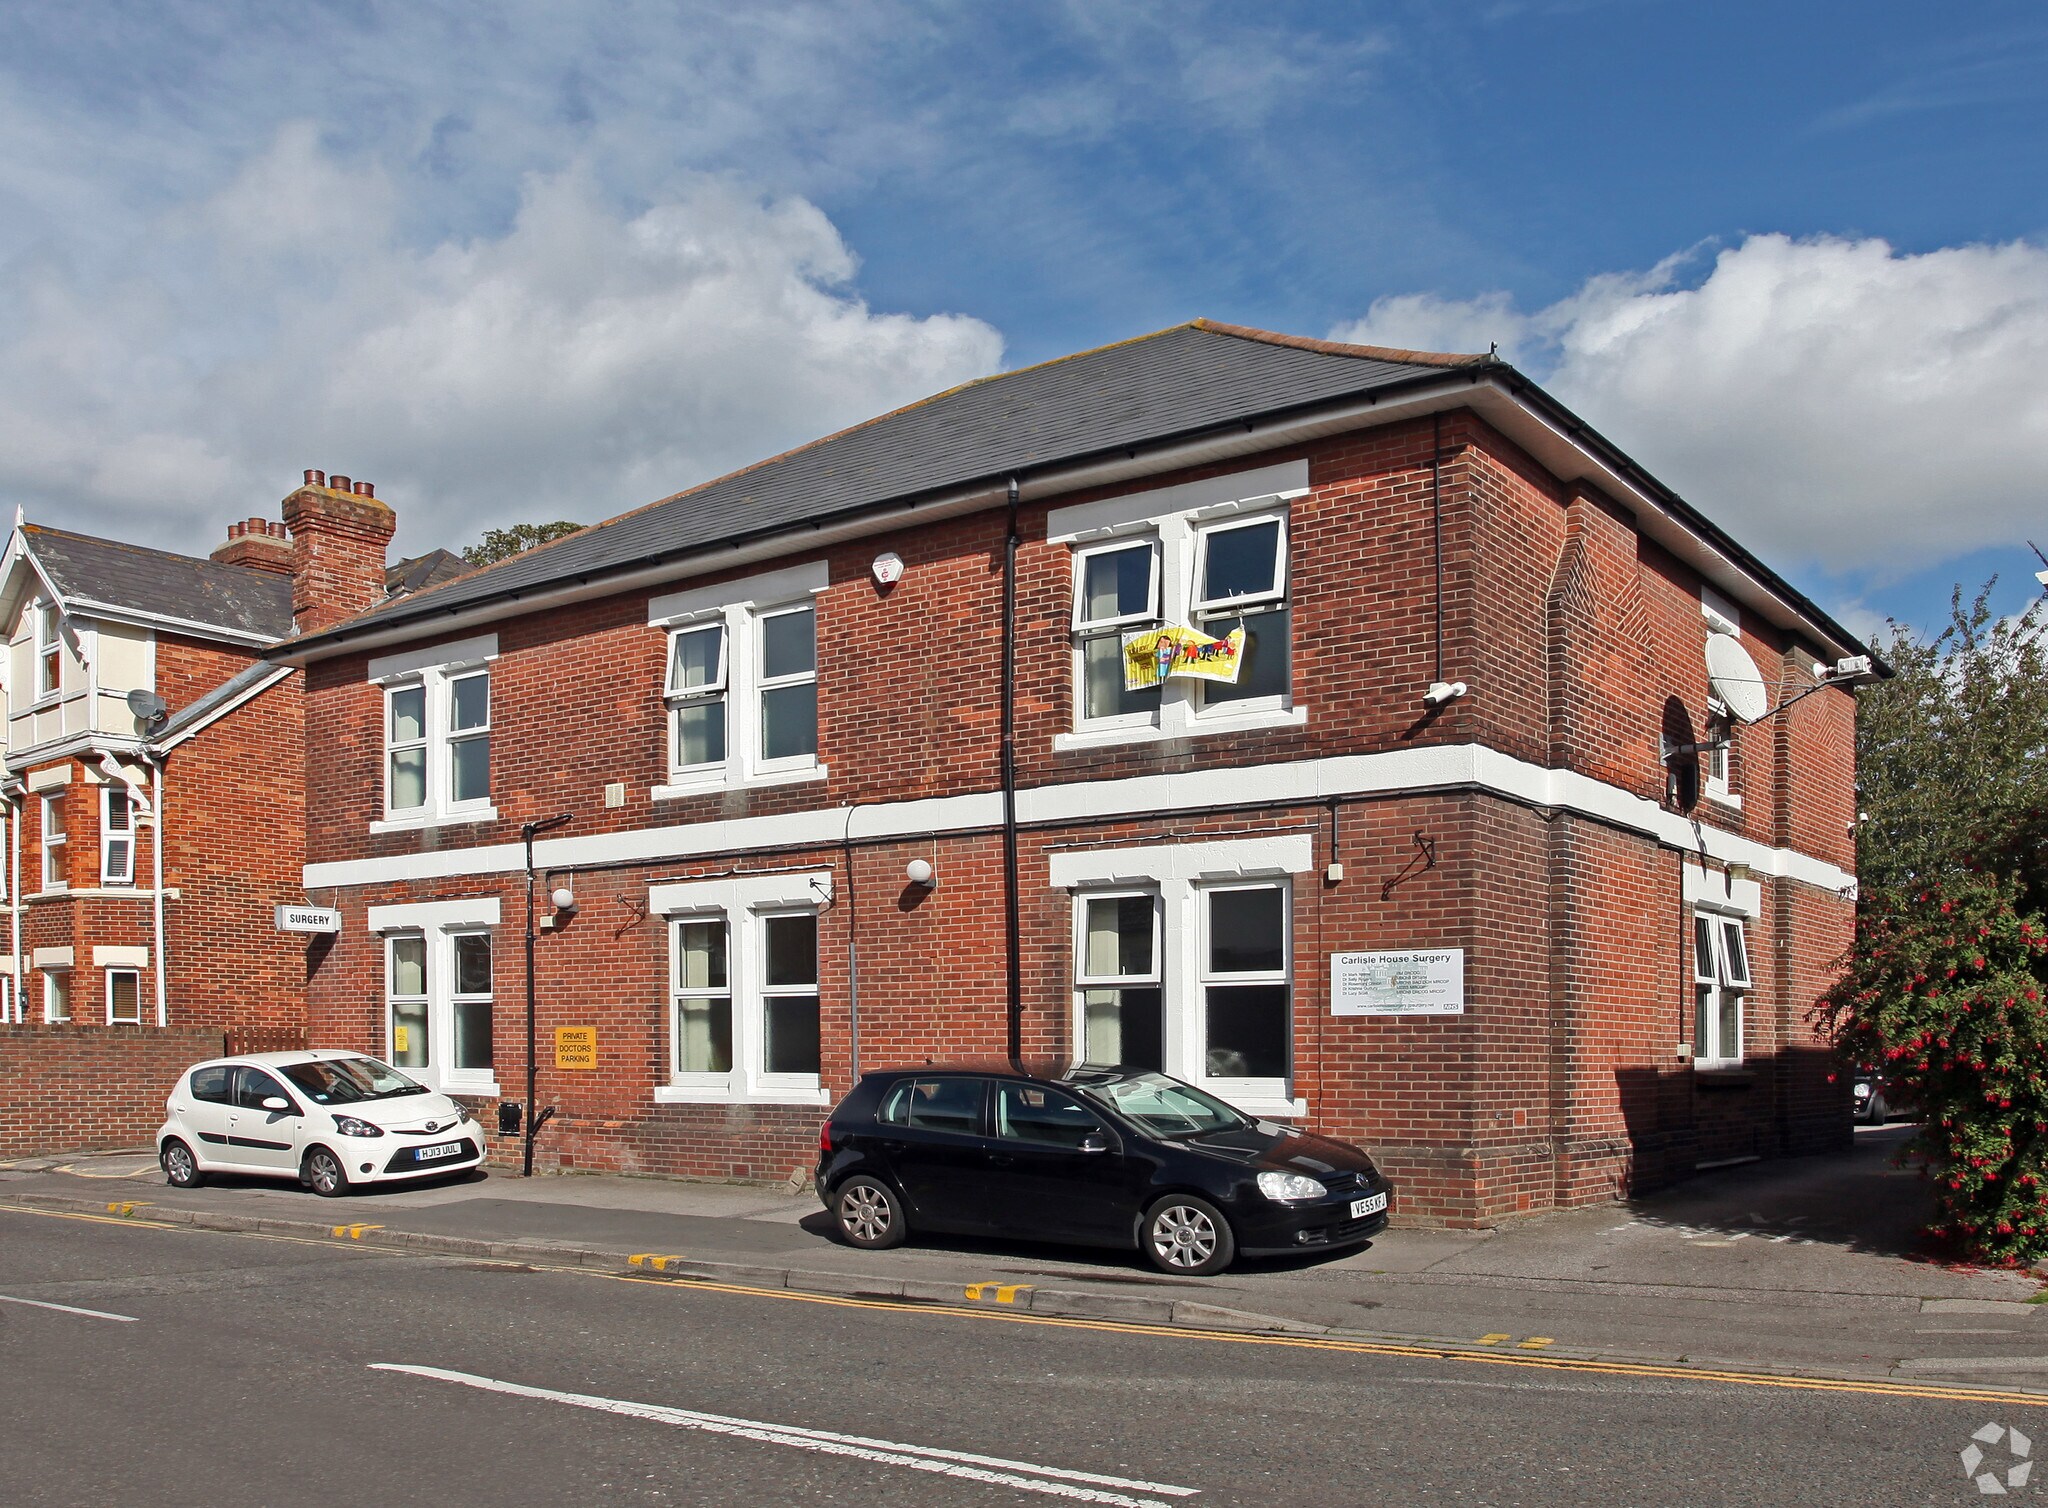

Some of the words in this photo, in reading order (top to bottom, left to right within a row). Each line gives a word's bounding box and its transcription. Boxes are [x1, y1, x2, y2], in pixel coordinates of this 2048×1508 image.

[290, 914, 330, 925] SURGERY
[1341, 955, 1376, 965] Carlisle
[1379, 955, 1410, 964] House
[1412, 954, 1451, 964] Surgery
[562, 1032, 588, 1040] PRIVATE
[559, 1045, 592, 1053] DOCTORS
[561, 1055, 590, 1063] PARKING
[442, 1144, 458, 1155] UUL
[1355, 1199, 1375, 1215] VE55
